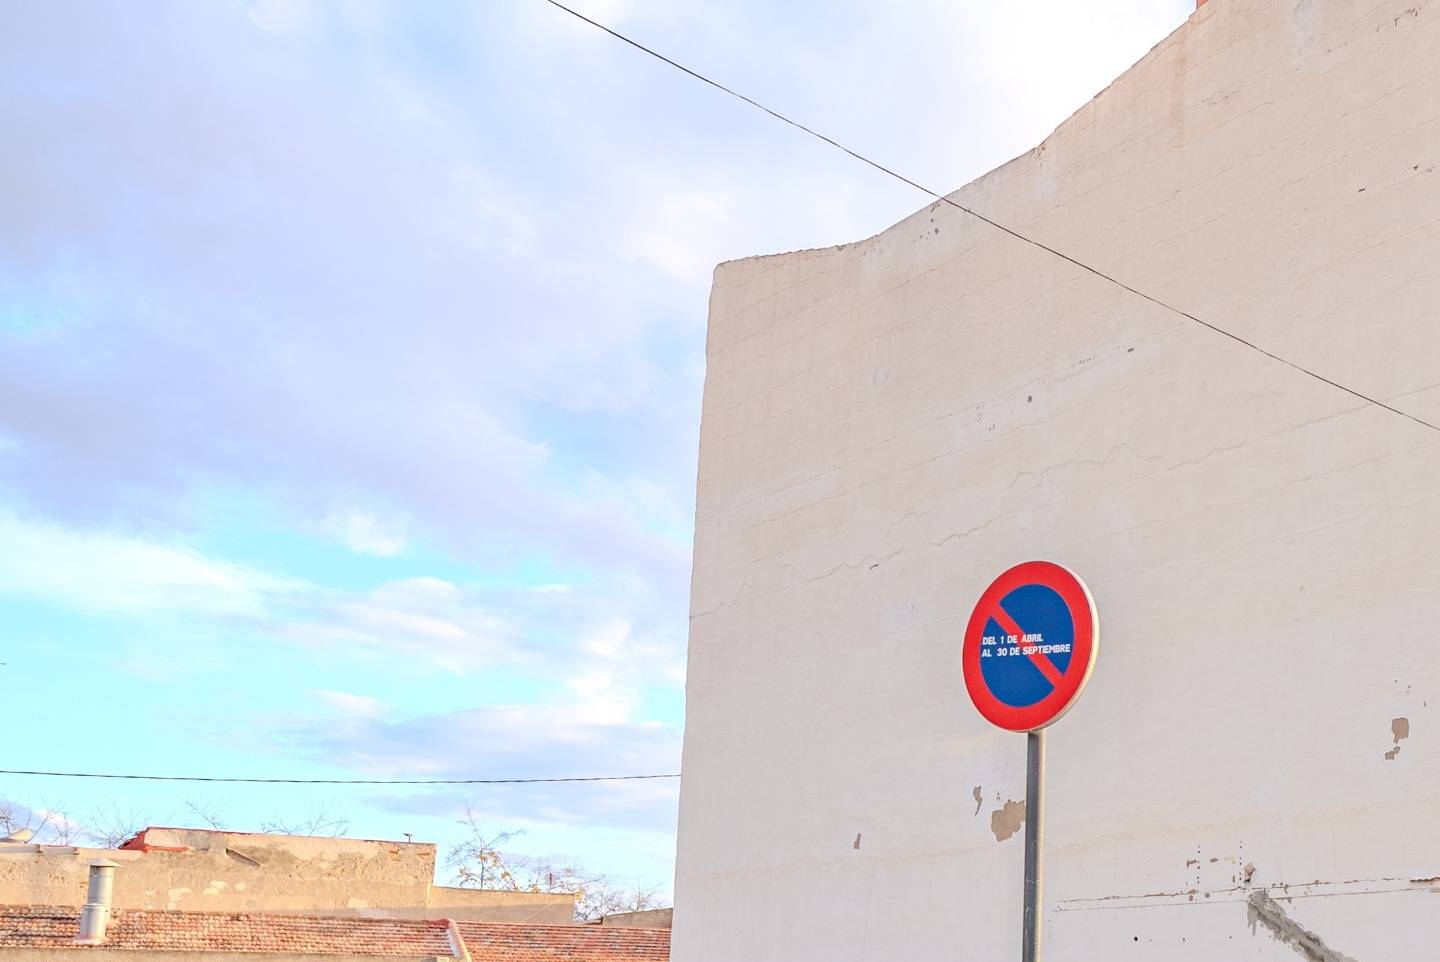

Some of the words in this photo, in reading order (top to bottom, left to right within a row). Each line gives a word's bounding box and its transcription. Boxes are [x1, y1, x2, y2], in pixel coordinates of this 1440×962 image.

[982, 636, 996, 645] DEL
[1000, 635, 1005, 644] 1
[1007, 635, 1018, 644] DE
[1021, 634, 1044, 643] ABRIL
[981, 649, 992, 658] AL
[997, 647, 1008, 657] 30
[1009, 646, 1020, 656] DE
[1022, 643, 1071, 655] SEPTIEMBRE
